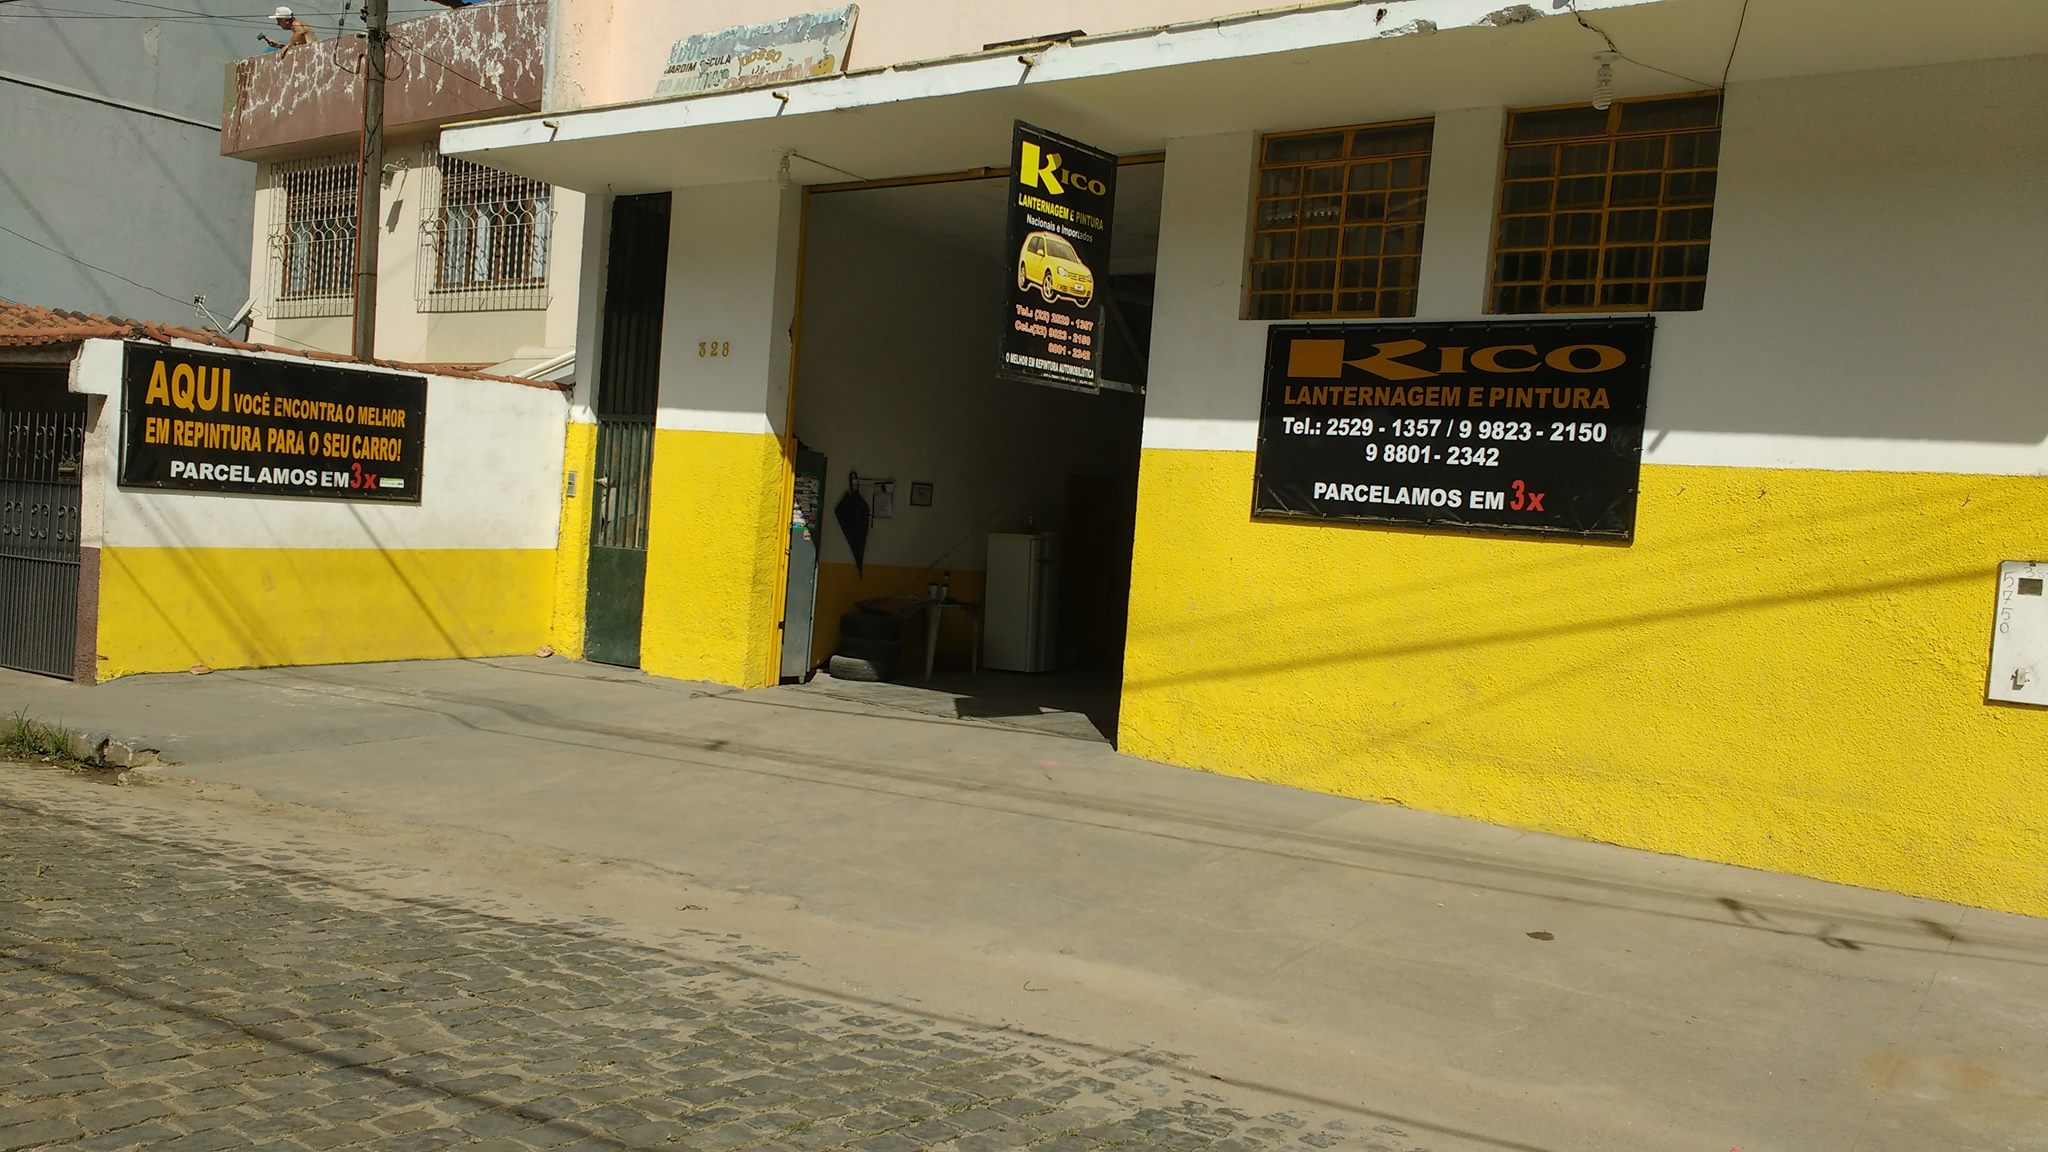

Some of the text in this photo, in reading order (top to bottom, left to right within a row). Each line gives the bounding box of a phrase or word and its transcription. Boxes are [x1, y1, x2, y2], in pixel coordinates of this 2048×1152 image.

[664, 61, 697, 75] JARDIM
[1020, 141, 1106, 197] KICO
[1018, 193, 1103, 230] LANTERNAGEM E PINTURA
[699, 341, 729, 357] 328
[1287, 339, 1626, 380] KICO
[146, 361, 405, 428] AQUI VOCÊ ENCONTRA O MELHOR
[1285, 386, 1610, 409] LANTERNAGEM E PINTURA
[145, 417, 401, 461] EM REPINTURA PARA O SEU CARRO!
[1283, 417, 1321, 434] Tel.:
[1327, 418, 1373, 436] 2529
[1392, 419, 1441, 437] 1357
[1459, 420, 1472, 438] 9
[1479, 421, 1531, 441] 9823
[1550, 423, 1606, 442] 2150
[1366, 444, 1377, 461] 9
[1447, 447, 1499, 466] 2342
[171, 461, 317, 485] PARCELAMOS
[321, 471, 349, 487] EM
[350, 463, 376, 489] 3x
[1314, 480, 1544, 511] PARCELAMOS EM 3x
